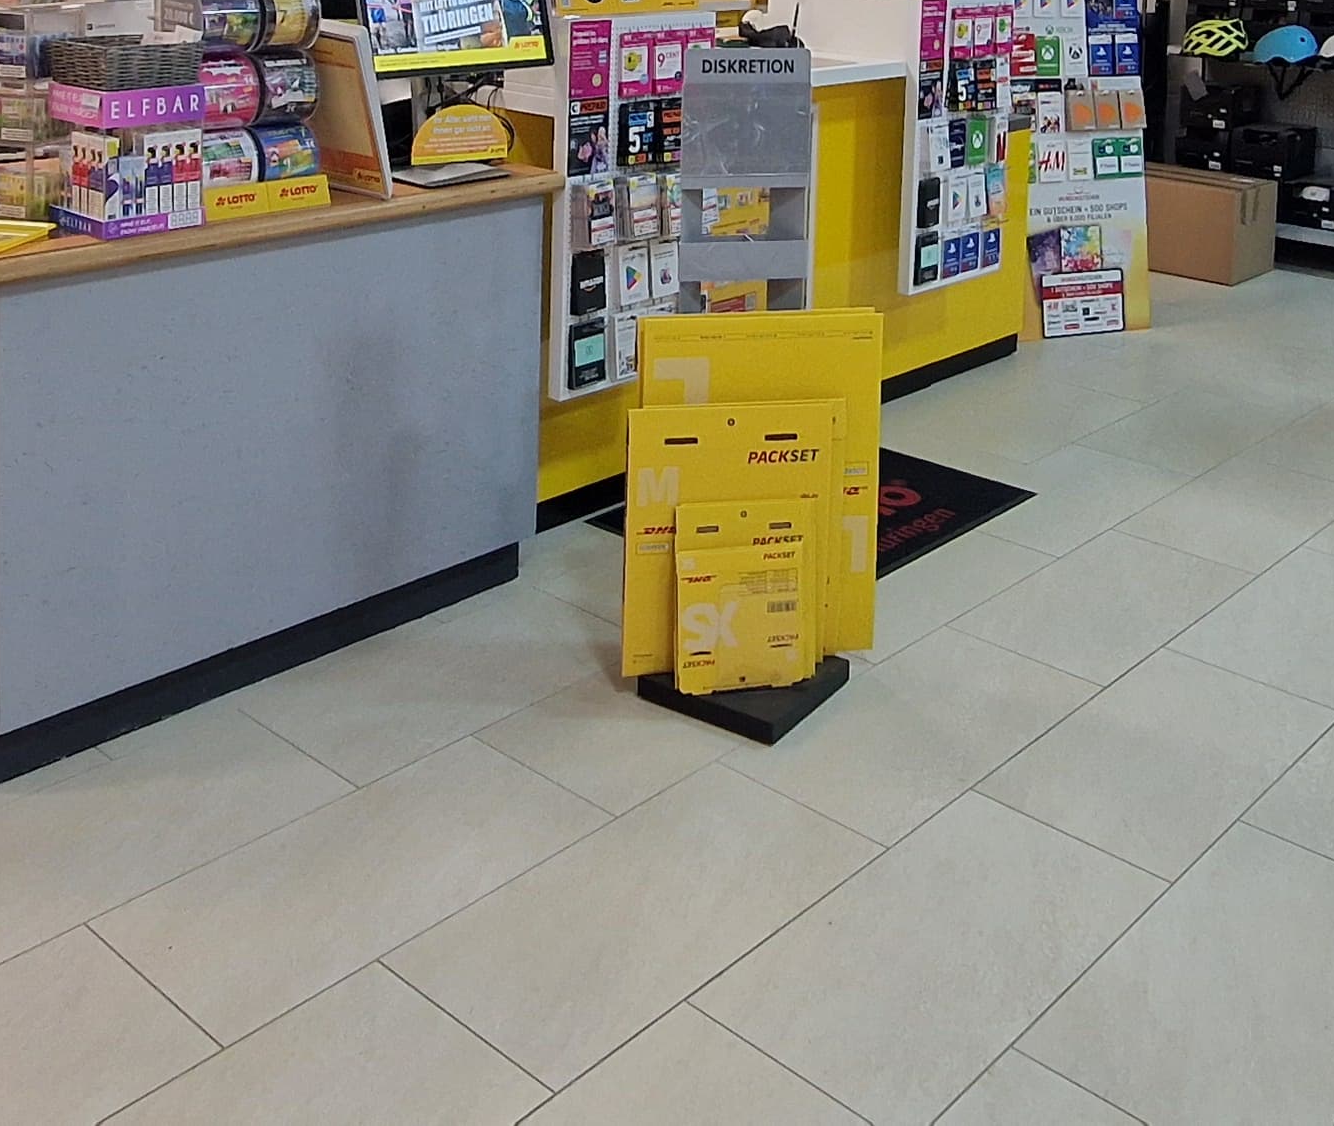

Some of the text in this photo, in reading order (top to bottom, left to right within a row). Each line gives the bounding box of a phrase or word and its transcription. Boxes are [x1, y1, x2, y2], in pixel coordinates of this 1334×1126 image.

[421, 3, 494, 34] THÜRINGEN
[657, 52, 665, 68] 9
[702, 59, 795, 74] DISKRETION
[957, 79, 969, 101] 5
[111, 94, 200, 119] ELFBAR
[628, 126, 646, 154] 5
[289, 185, 317, 196] LOTTO
[227, 194, 255, 204] LOTTO
[1029, 208, 1042, 216] EIN
[1043, 205, 1082, 215] GUTSCHEIN
[1090, 203, 1104, 213] 500
[1106, 202, 1128, 212] SHOPS
[748, 448, 820, 464] PACKSET
[637, 466, 680, 507] M
[752, 534, 804, 546] PACKSET
[763, 551, 796, 560] PACKSET
